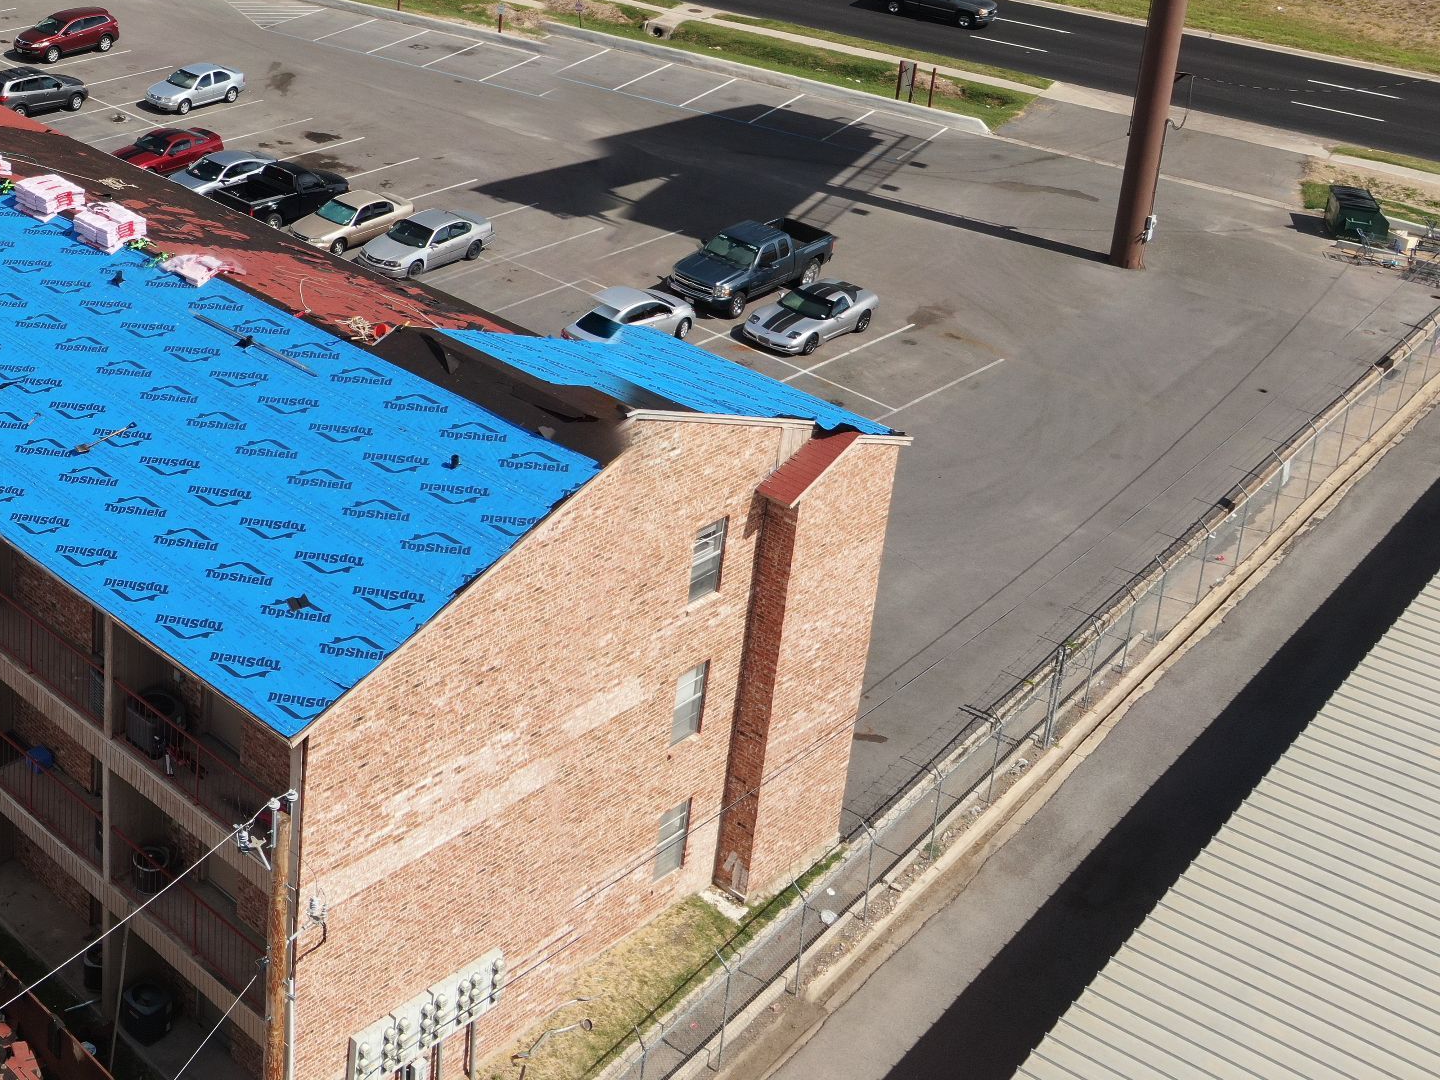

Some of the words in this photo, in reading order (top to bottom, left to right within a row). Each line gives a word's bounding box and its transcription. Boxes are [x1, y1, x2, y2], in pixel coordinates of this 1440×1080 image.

[2, 259, 53, 268] TopShield
[40, 279, 92, 288] TopShield
[79, 299, 133, 309] TopShield
[187, 301, 245, 312] TopShield
[15, 320, 67, 330] TopShield
[120, 322, 176, 332] TopShield
[232, 324, 291, 336] TopShield
[54, 342, 110, 353] TopShield
[163, 345, 221, 356] TopShield
[279, 348, 341, 360] TopShield
[96, 366, 153, 378] TopShield
[210, 370, 269, 381] TopShield
[329, 374, 393, 386] TopShield
[139, 391, 199, 404] TopShield
[257, 395, 320, 408] TopShield
[48, 401, 106, 413] TopShield
[383, 401, 449, 414] TopShield
[185, 419, 248, 431] TopShield
[308, 423, 373, 436] TopShield
[439, 429, 507, 443] TopShield
[14, 444, 73, 458] TopShield
[235, 446, 299, 460] TopShield
[139, 455, 201, 469] TopShield
[363, 452, 431, 466] TopShield
[498, 458, 570, 473] TopShield
[58, 473, 119, 487] TopShield
[286, 475, 353, 490] TopShield
[188, 485, 253, 500] TopShield
[420, 482, 491, 497] TopShield
[104, 503, 168, 518] TopShield
[341, 507, 411, 522] TopShield
[10, 512, 71, 528] TopShield
[239, 516, 307, 532] TopShield
[153, 534, 219, 551] TopShield
[400, 540, 472, 556] TopShield
[55, 544, 119, 560] TopShield
[294, 550, 364, 567] TopShield
[205, 569, 274, 587] TopShield
[103, 577, 169, 595] TopShield
[352, 585, 426, 604] TopShield
[260, 604, 333, 624] TopShield
[155, 613, 224, 632] TopShield
[209, 652, 282, 672] TopShield
